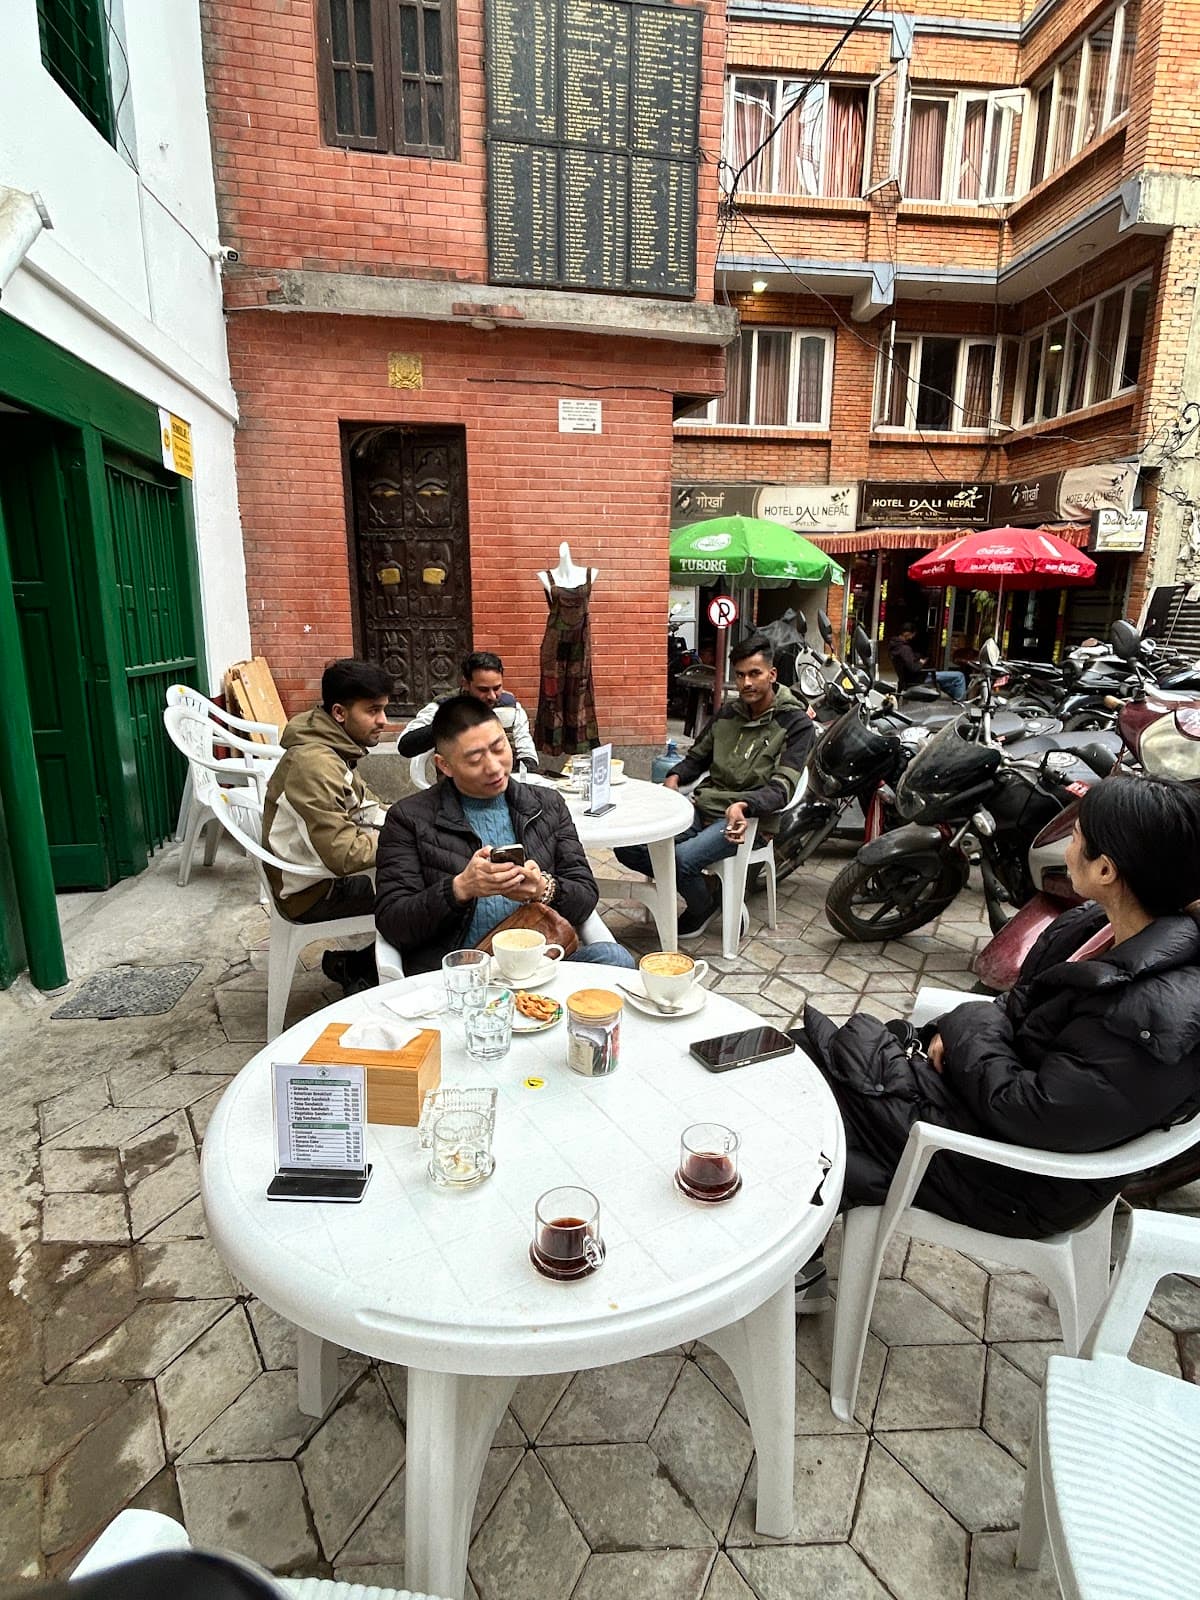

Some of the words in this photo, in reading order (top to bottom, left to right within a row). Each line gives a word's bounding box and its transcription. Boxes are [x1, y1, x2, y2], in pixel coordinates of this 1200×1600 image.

[696, 491, 725, 508] गोर्खा
[872, 498, 904, 508] HOTEL
[909, 498, 941, 509] DALI
[946, 499, 976, 508] NEPAL
[764, 506, 794, 516] HOTEL
[796, 505, 820, 518] DALI
[822, 505, 850, 516] NEPAL
[679, 558, 727, 573] TUBORG
